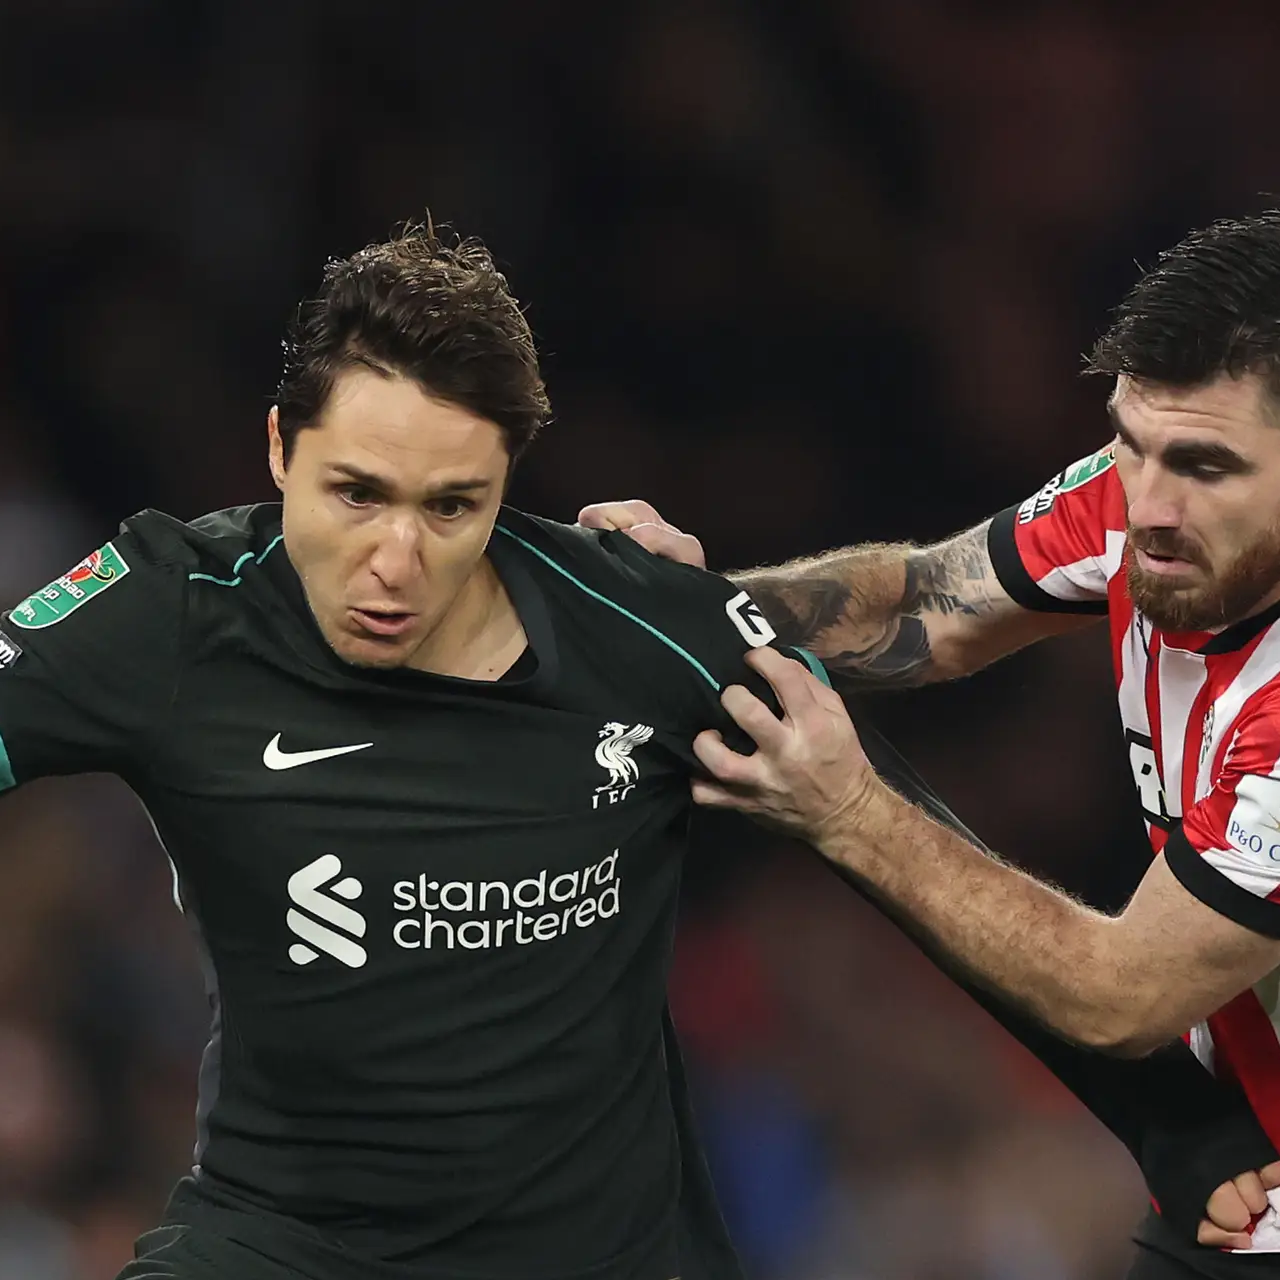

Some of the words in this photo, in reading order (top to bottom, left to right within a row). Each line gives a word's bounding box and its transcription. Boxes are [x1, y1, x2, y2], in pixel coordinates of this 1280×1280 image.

[1229, 820, 1264, 853] P&O
[393, 848, 619, 912] standard
[392, 877, 621, 949] chartered
